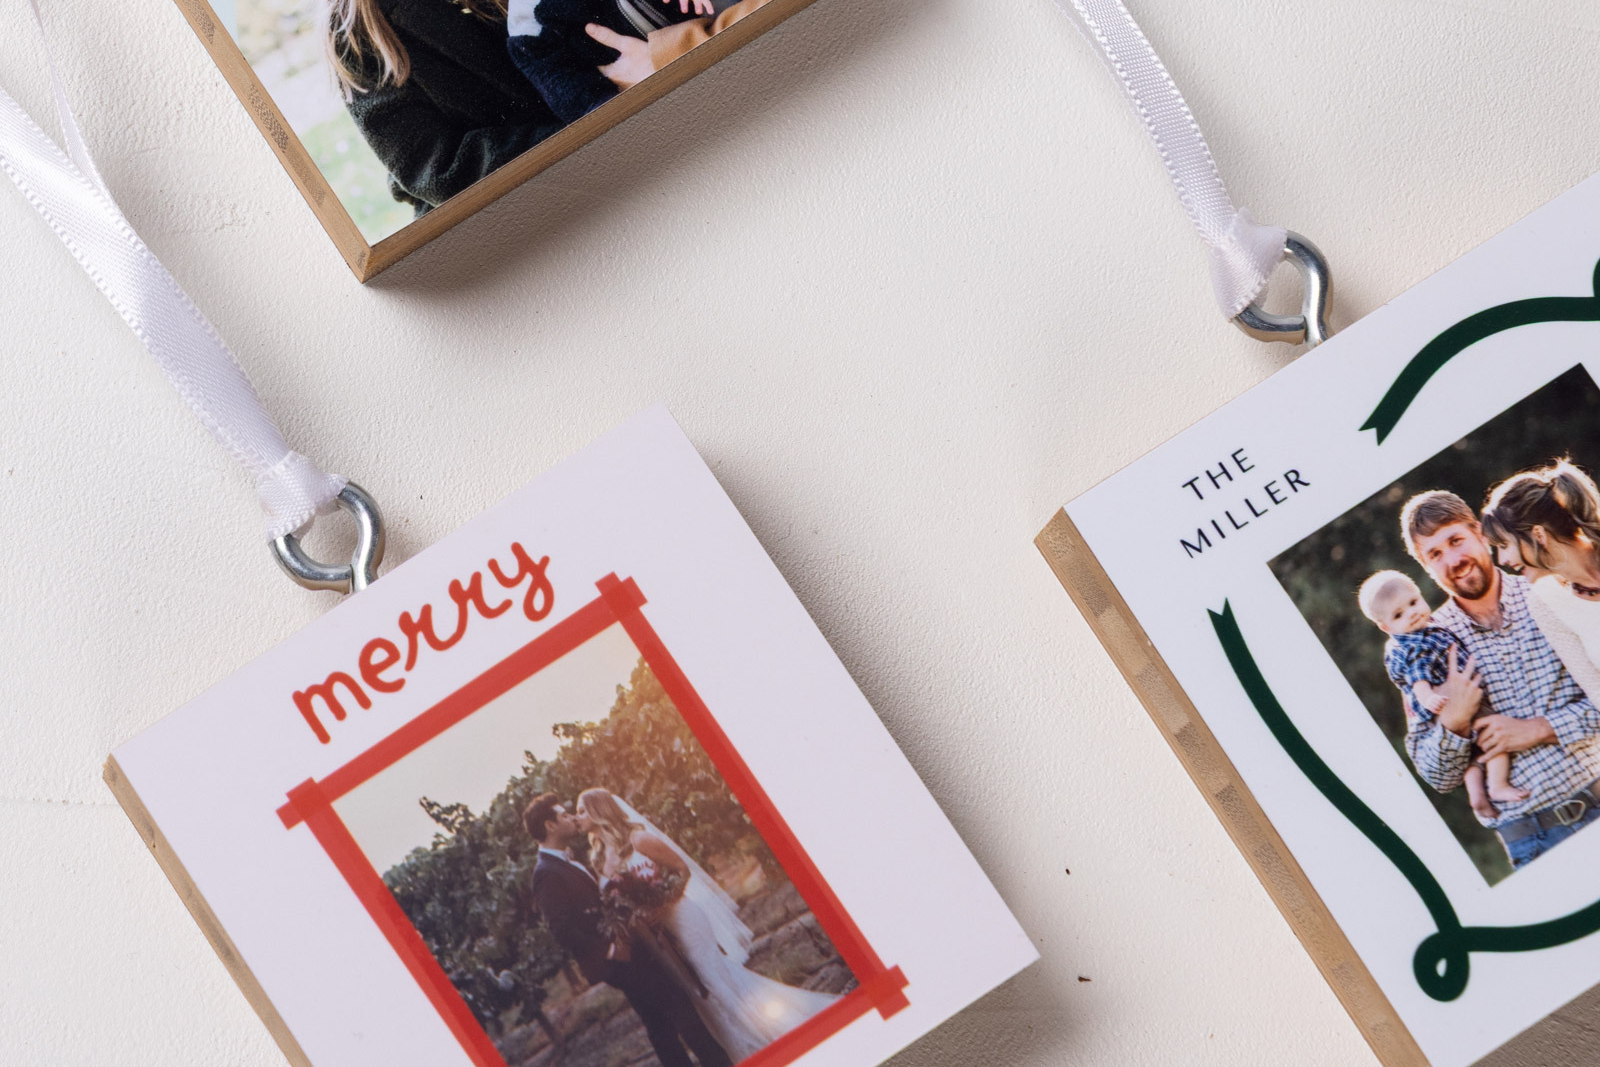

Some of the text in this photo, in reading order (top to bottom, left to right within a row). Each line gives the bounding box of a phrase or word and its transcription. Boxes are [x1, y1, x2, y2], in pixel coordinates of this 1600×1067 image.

[1179, 468, 1311, 559] MILLER
[1181, 447, 1256, 501] THE
[291, 541, 556, 745] merry
